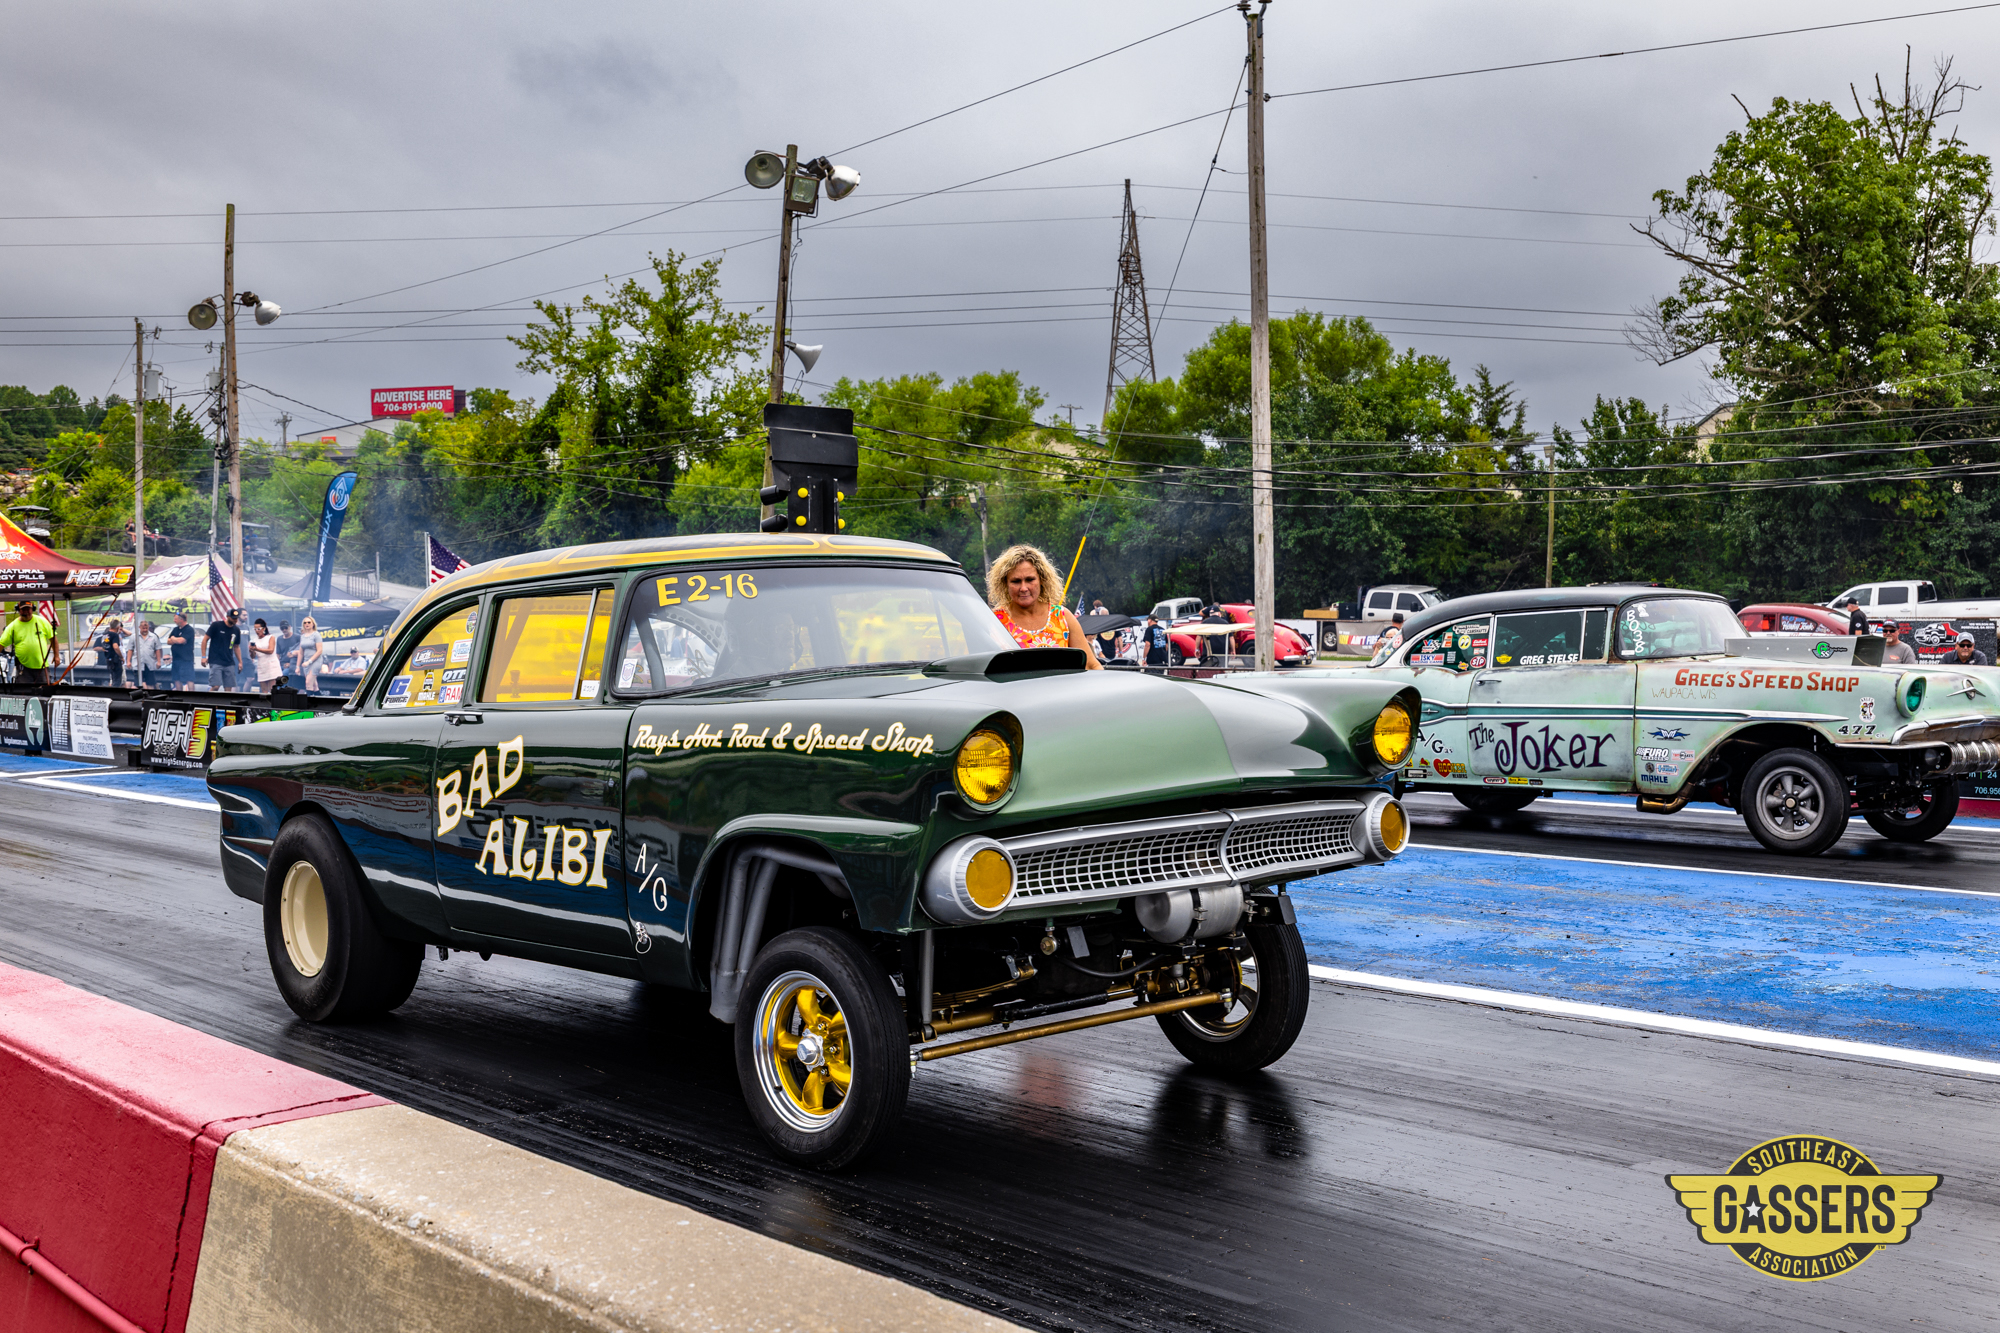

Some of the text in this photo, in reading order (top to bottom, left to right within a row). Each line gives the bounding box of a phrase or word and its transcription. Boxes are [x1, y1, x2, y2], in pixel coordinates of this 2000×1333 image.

[374, 389, 452, 402] ADVERTISE HERE
[383, 402, 442, 412] 706-891-9000
[656, 574, 758, 607] E 2-16
[340, 627, 366, 637] ONLY
[1472, 657, 1485, 666] STP
[1520, 654, 1579, 664] GREG STELSE
[1838, 725, 1877, 735] 477
[632, 722, 934, 758] Rays Hot Rod & Speed Shop
[1468, 721, 1616, 775] The Joker
[151, 756, 203, 769] www.high5energy.com
[1438, 762, 1467, 773] HOOKER
[1641, 774, 1668, 783] MAHLE
[436, 734, 523, 837] BAD
[474, 816, 612, 889] ALIBI
